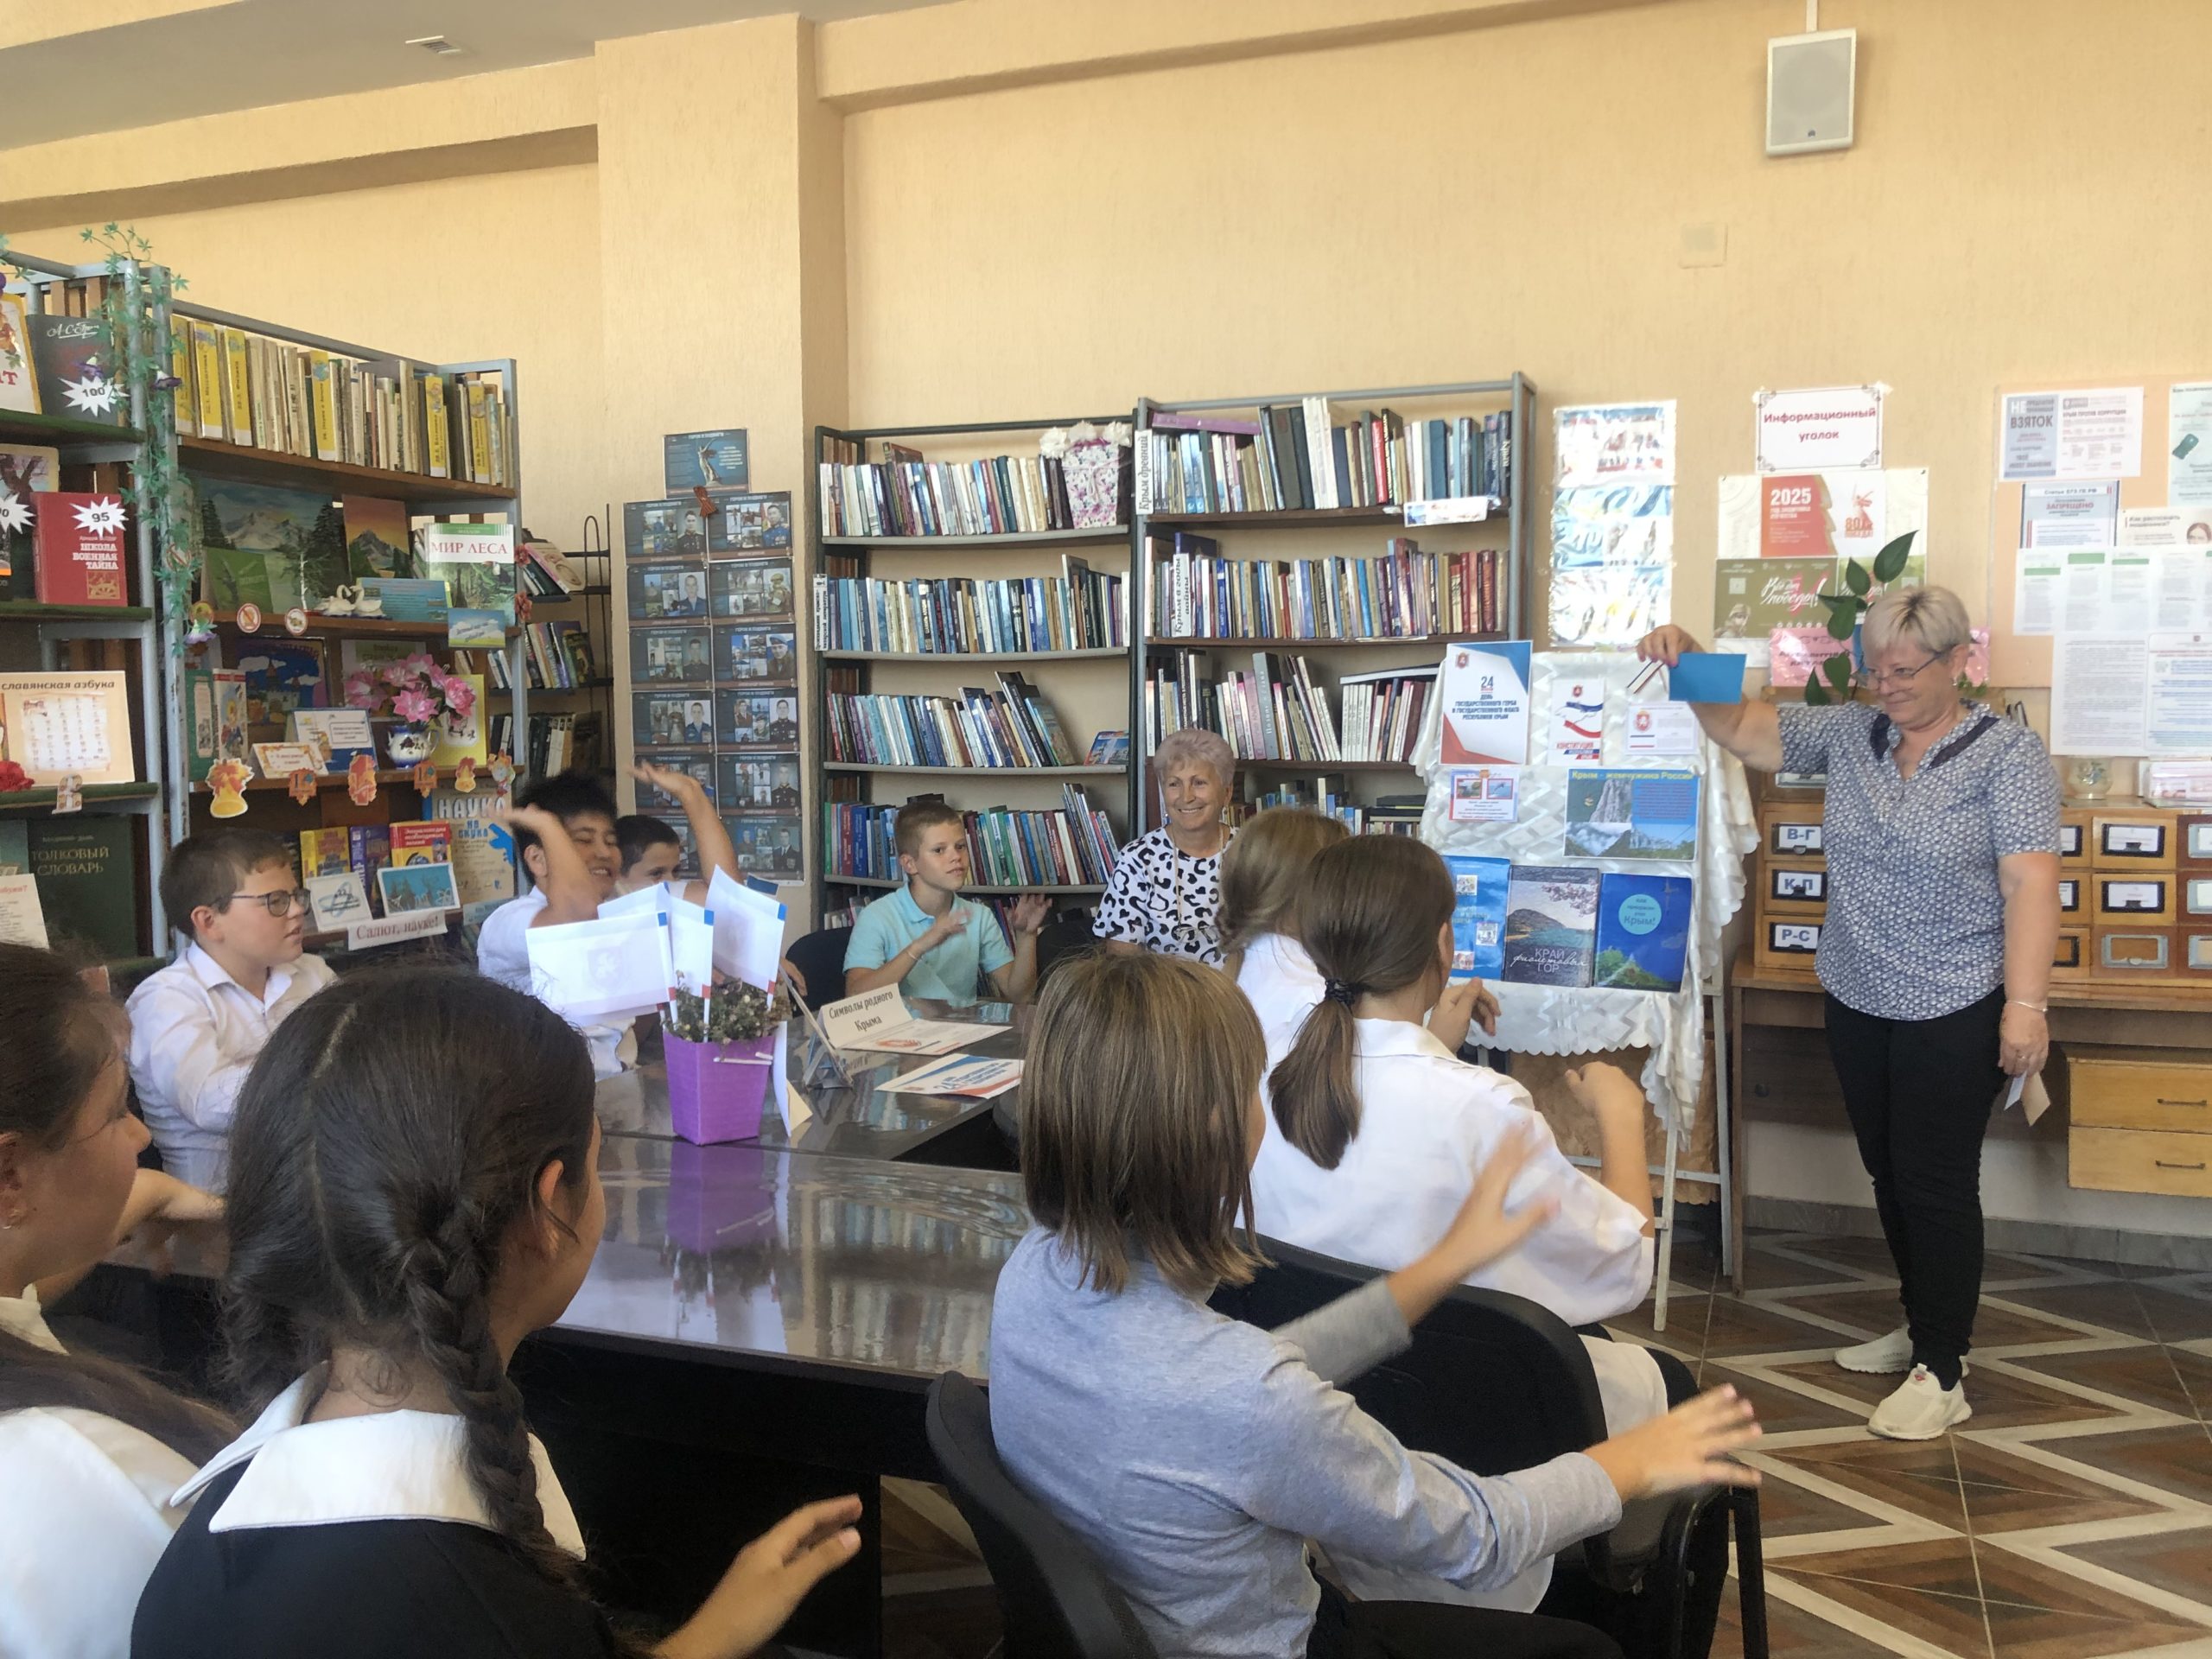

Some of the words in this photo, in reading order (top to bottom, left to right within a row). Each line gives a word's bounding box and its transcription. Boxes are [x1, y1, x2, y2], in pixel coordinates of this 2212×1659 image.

[82, 387, 105, 397] 100
[1764, 408, 1877, 423] Информационный
[2011, 415, 2053, 429] ВЗЯТОК
[1799, 430, 1840, 443] уголок
[1137, 435, 1151, 478] древний
[1139, 479, 1152, 511] Крым
[1770, 487, 1812, 506] 2025
[91, 512, 110, 523] 95
[80, 543, 118, 551] ШКОЛА
[431, 542, 464, 554] МИР
[467, 543, 508, 555] ЛЕСА
[73, 552, 118, 561] ВОЕННАЯ
[86, 562, 118, 570] ТАЙНА
[1, 681, 71, 690] славянская
[73, 679, 115, 692] азбука
[1480, 676, 1494, 689] 24
[1556, 741, 1594, 750] КОНСТИТУЦИЯ
[1572, 771, 1598, 779] Крым
[1605, 772, 1659, 780] жемчужина
[1787, 828, 1815, 841] В-Г
[31, 846, 110, 861] ТОЛКОВЫЙ
[37, 862, 104, 876] СЛОВАРЬ
[1784, 878, 1814, 890] К-П
[1624, 916, 1656, 926] Крым!
[356, 922, 400, 941] Салют,
[404, 916, 439, 934] науке!
[1782, 929, 1810, 942] Р-С
[1510, 951, 1588, 967] фиолетовых
[1535, 948, 1565, 960] КРАЙ
[1537, 963, 1560, 973] ГОР
[829, 1000, 864, 1020] Символы
[864, 990, 893, 1011] родного
[855, 1015, 882, 1033] Крыма
